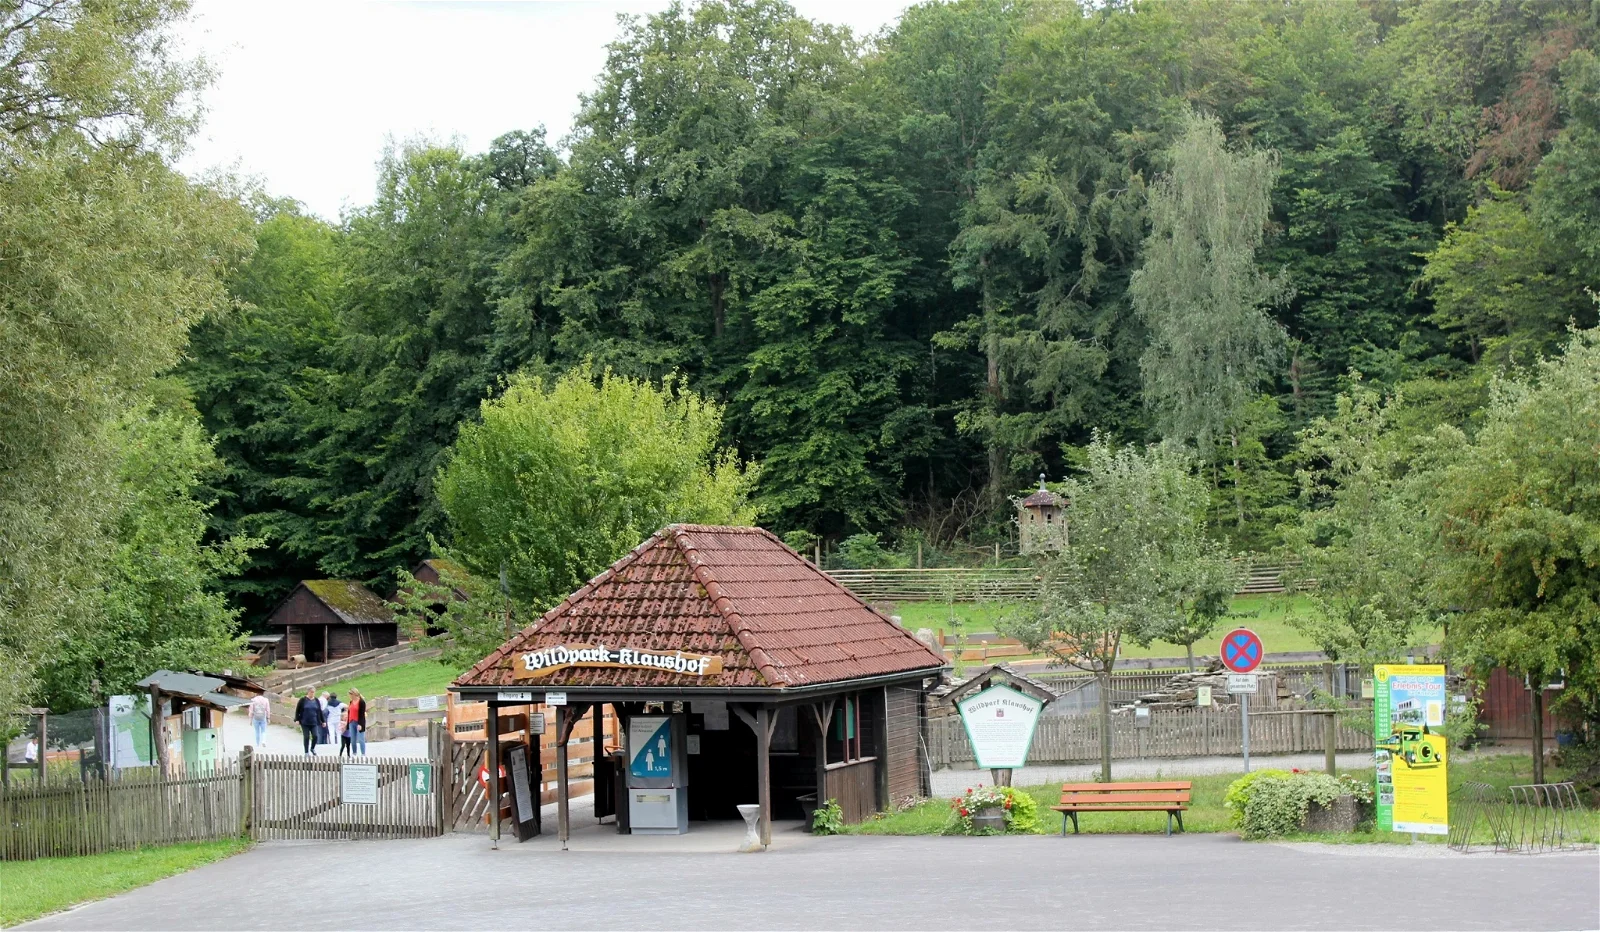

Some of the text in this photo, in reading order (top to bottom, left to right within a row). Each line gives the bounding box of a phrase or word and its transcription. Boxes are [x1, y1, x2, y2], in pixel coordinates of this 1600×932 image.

[521, 645, 711, 675] Wildpark-Klaushof
[968, 699, 1034, 714] Wildpark Klaushof
